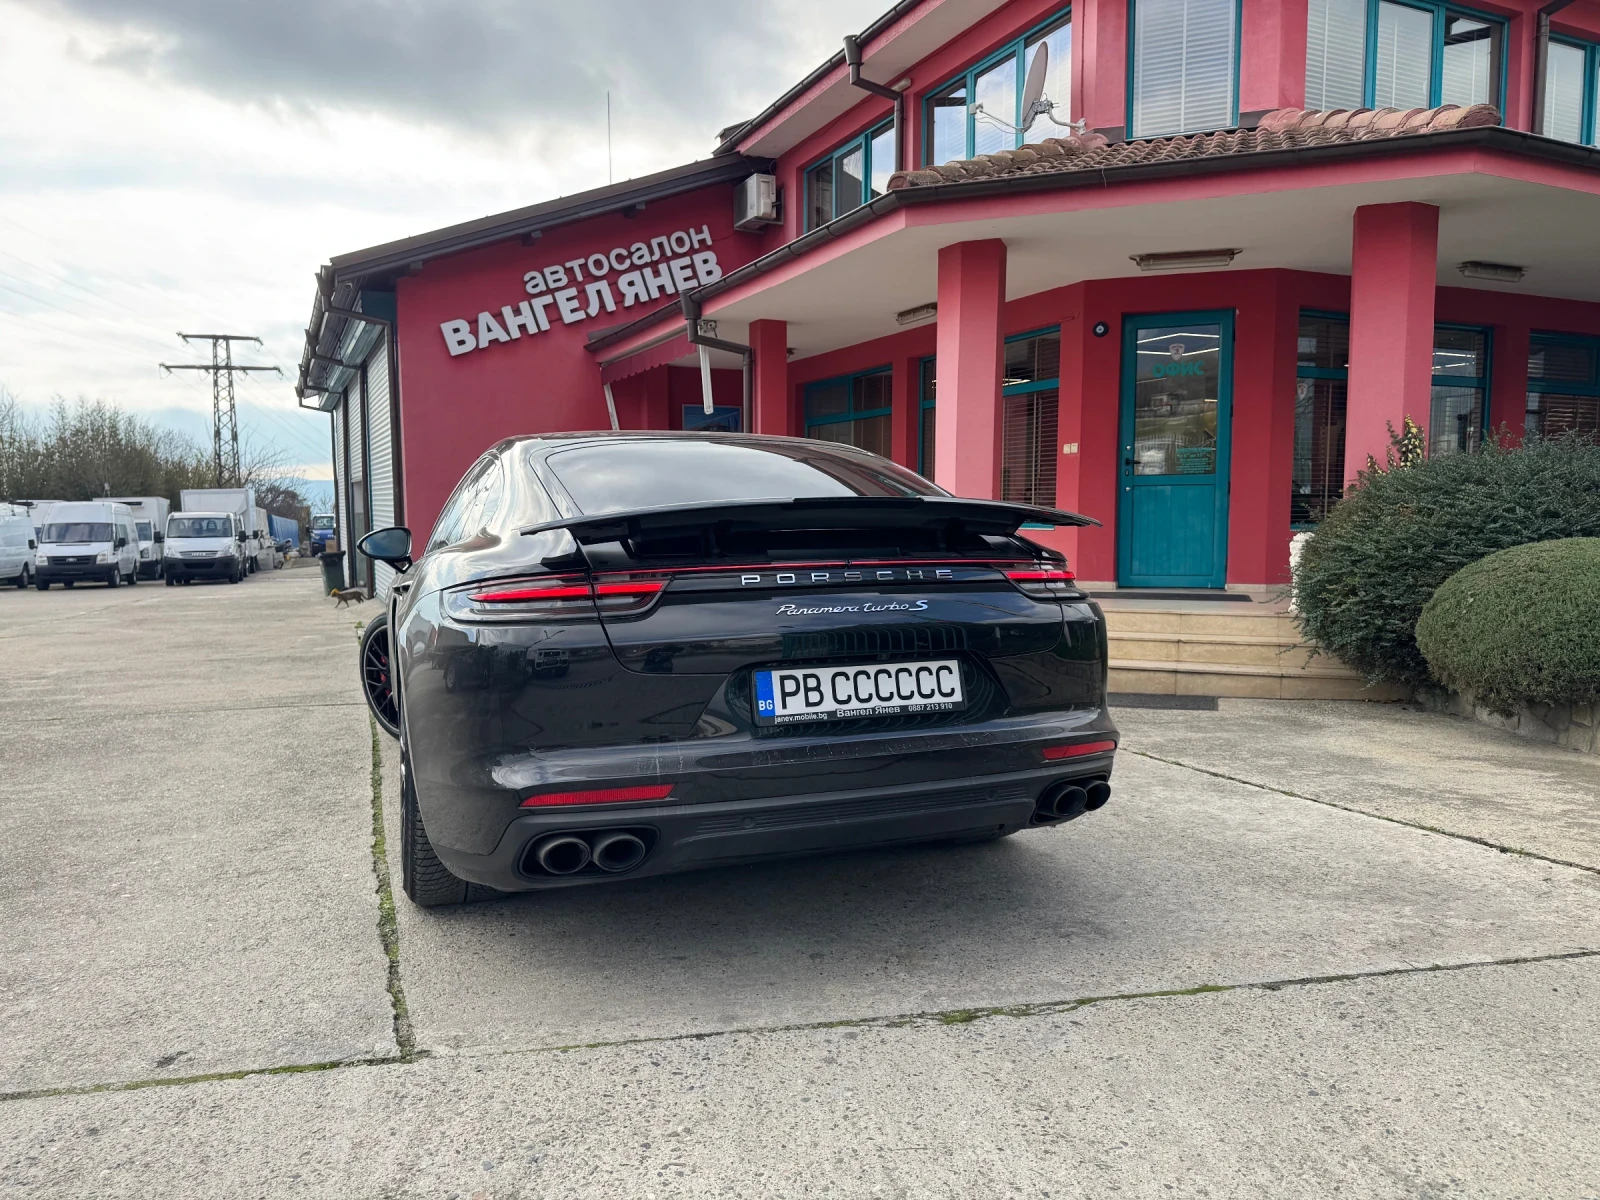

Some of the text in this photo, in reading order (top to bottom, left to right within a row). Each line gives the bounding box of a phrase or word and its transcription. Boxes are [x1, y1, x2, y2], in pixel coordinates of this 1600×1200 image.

[523, 224, 713, 294] автосалон
[439, 250, 723, 357] ВАНГЕЛ ЯНЕВ
[1152, 360, 1205, 378] ОФИС
[741, 569, 953, 586] PORSCHE
[775, 599, 929, 616] Panamera turbo S
[779, 665, 956, 710] PB CCCCCC
[758, 699, 773, 711] BG
[836, 704, 901, 718] Вангел Янев
[908, 702, 953, 712] 0887 213 910
[774, 712, 828, 724] janev.mobile.bg
